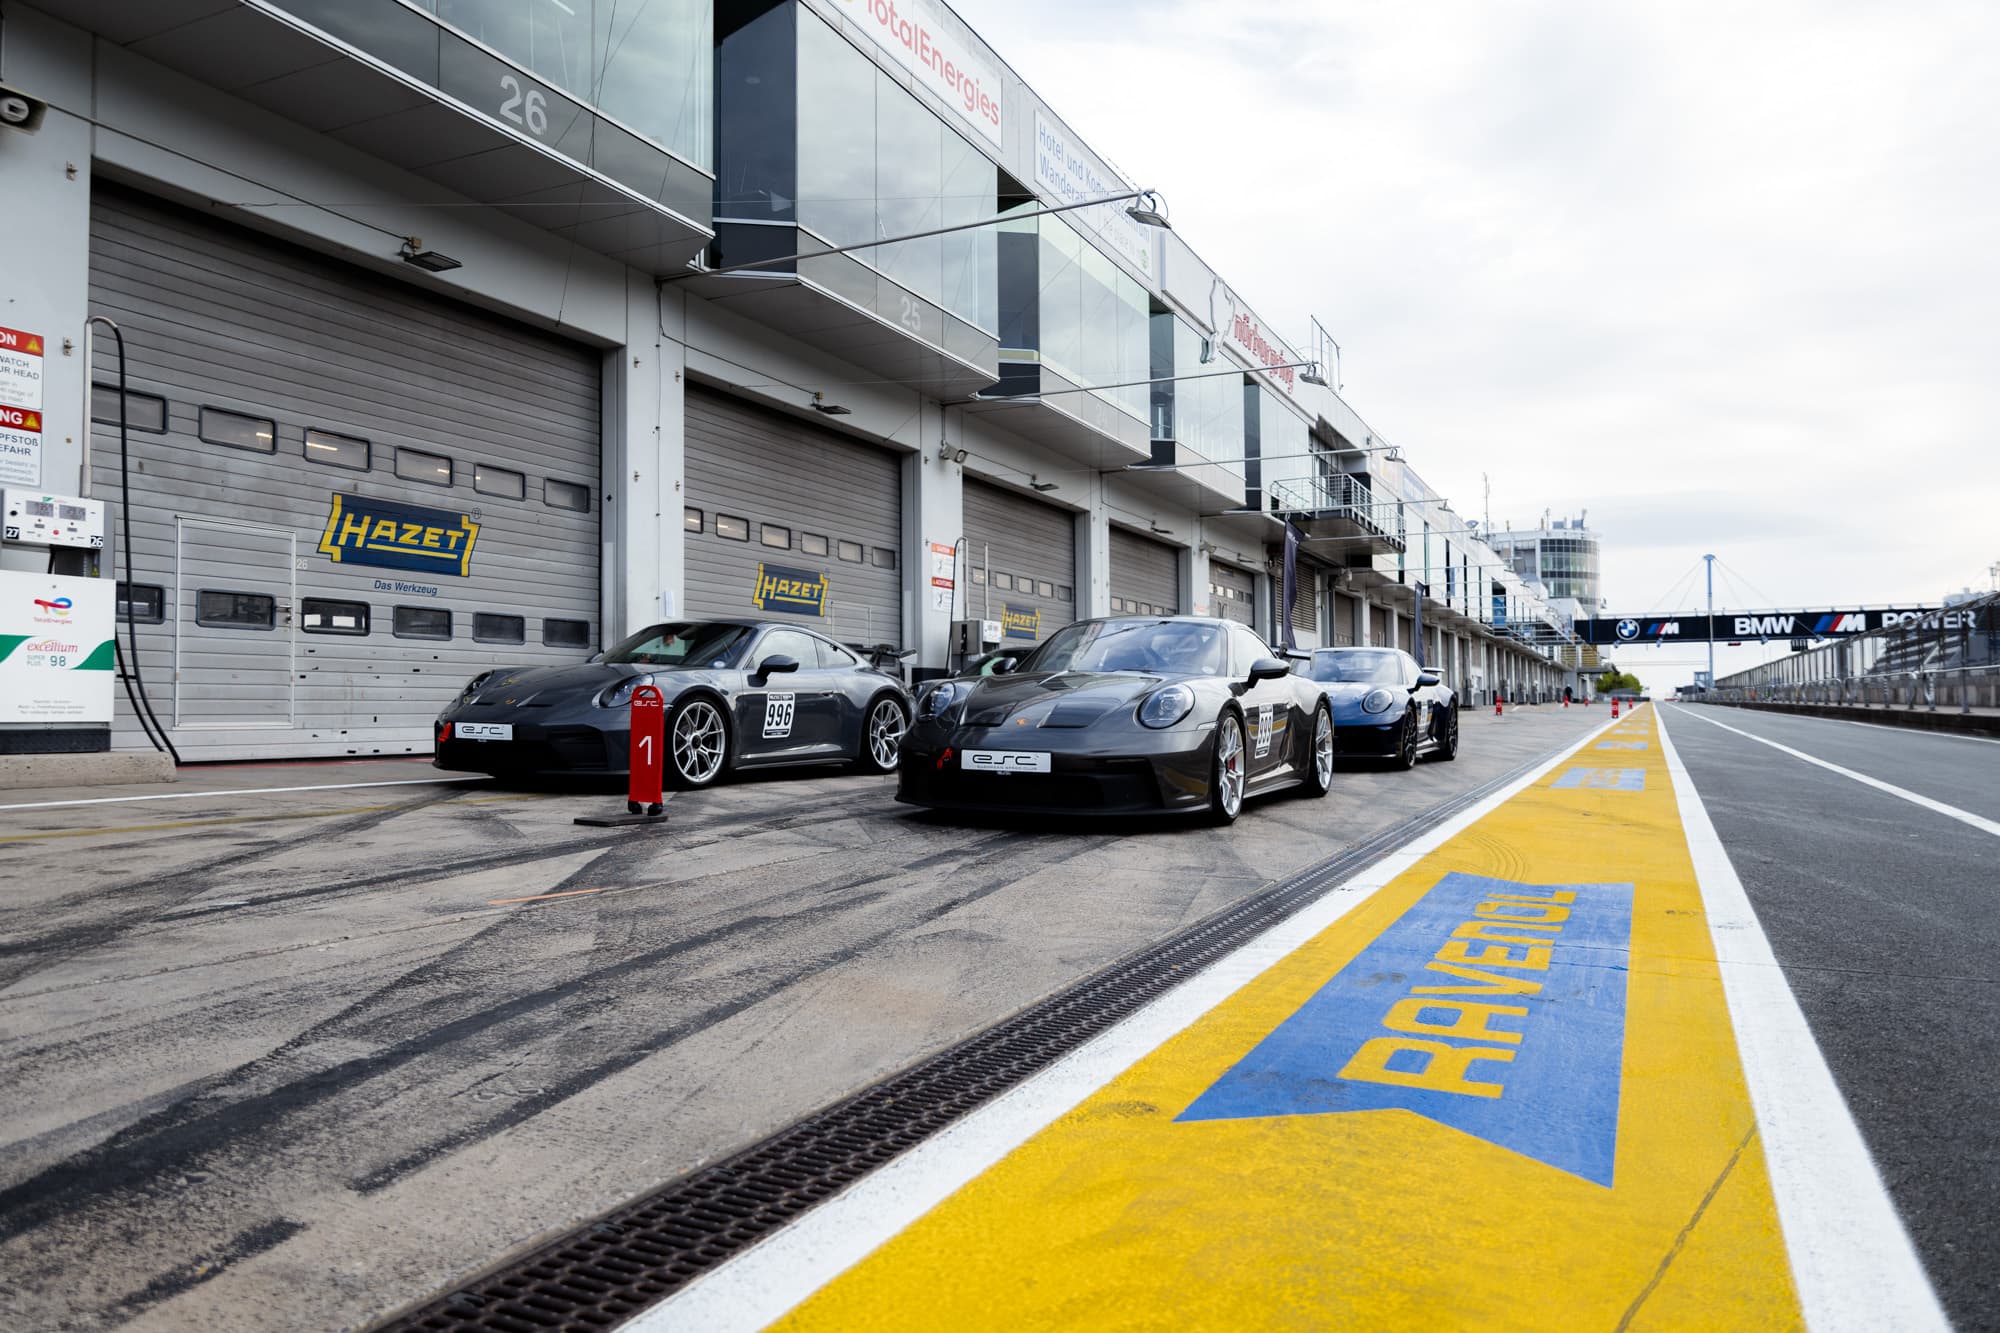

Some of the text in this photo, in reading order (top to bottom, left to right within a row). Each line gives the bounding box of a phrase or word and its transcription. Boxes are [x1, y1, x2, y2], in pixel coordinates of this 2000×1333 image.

[500, 75, 547, 135] 26
[1039, 122, 1064, 162] Hotel
[1066, 155, 1084, 181] und
[901, 296, 920, 331] 25
[13, 368, 40, 380] HEAD
[0, 409, 23, 425] NG
[7, 528, 19, 538] 27
[338, 513, 465, 550] HAZET
[91, 536, 103, 548] 26
[297, 559, 308, 570] 26
[374, 580, 438, 597] Das Werkzeug
[762, 576, 821, 599] HAZET
[1005, 610, 1037, 628] HAZET
[1734, 616, 1795, 635] BMW
[27, 641, 78, 652] excellium
[50, 655, 66, 667] 98
[767, 703, 792, 727] 996
[638, 735, 652, 766] 1
[1335, 890, 1578, 1099] RAVENOL
